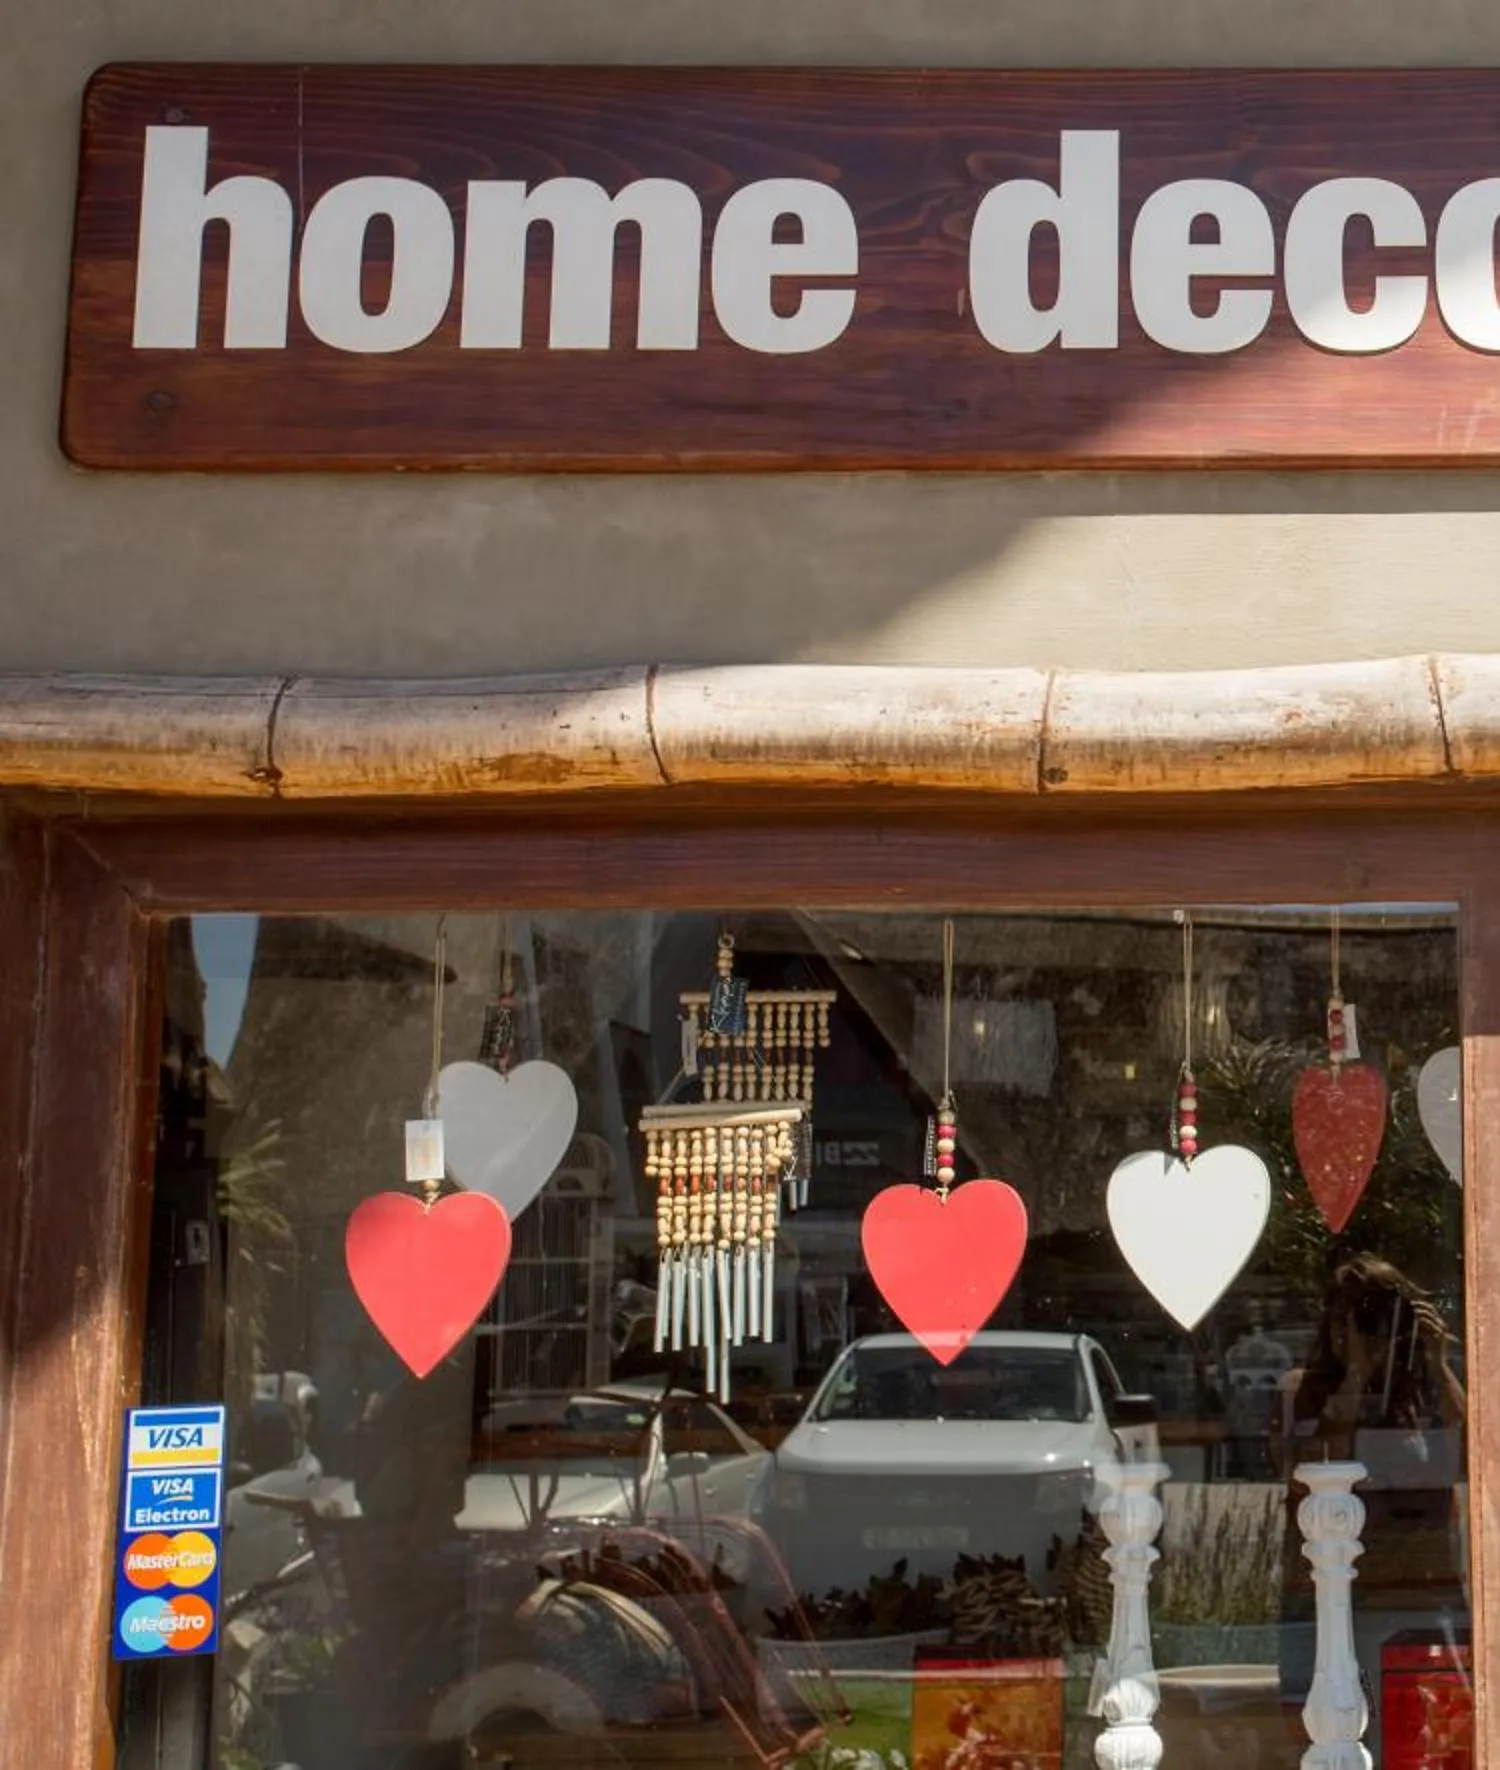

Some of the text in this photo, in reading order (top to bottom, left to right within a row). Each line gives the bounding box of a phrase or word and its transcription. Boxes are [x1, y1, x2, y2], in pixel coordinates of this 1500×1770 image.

[133, 125, 859, 353] home
[148, 1426, 203, 1448] VISA
[151, 1477, 194, 1496] VISA
[135, 1507, 210, 1524] Electron
[128, 1551, 213, 1571] MasterCard
[129, 1613, 206, 1633] Maestro
